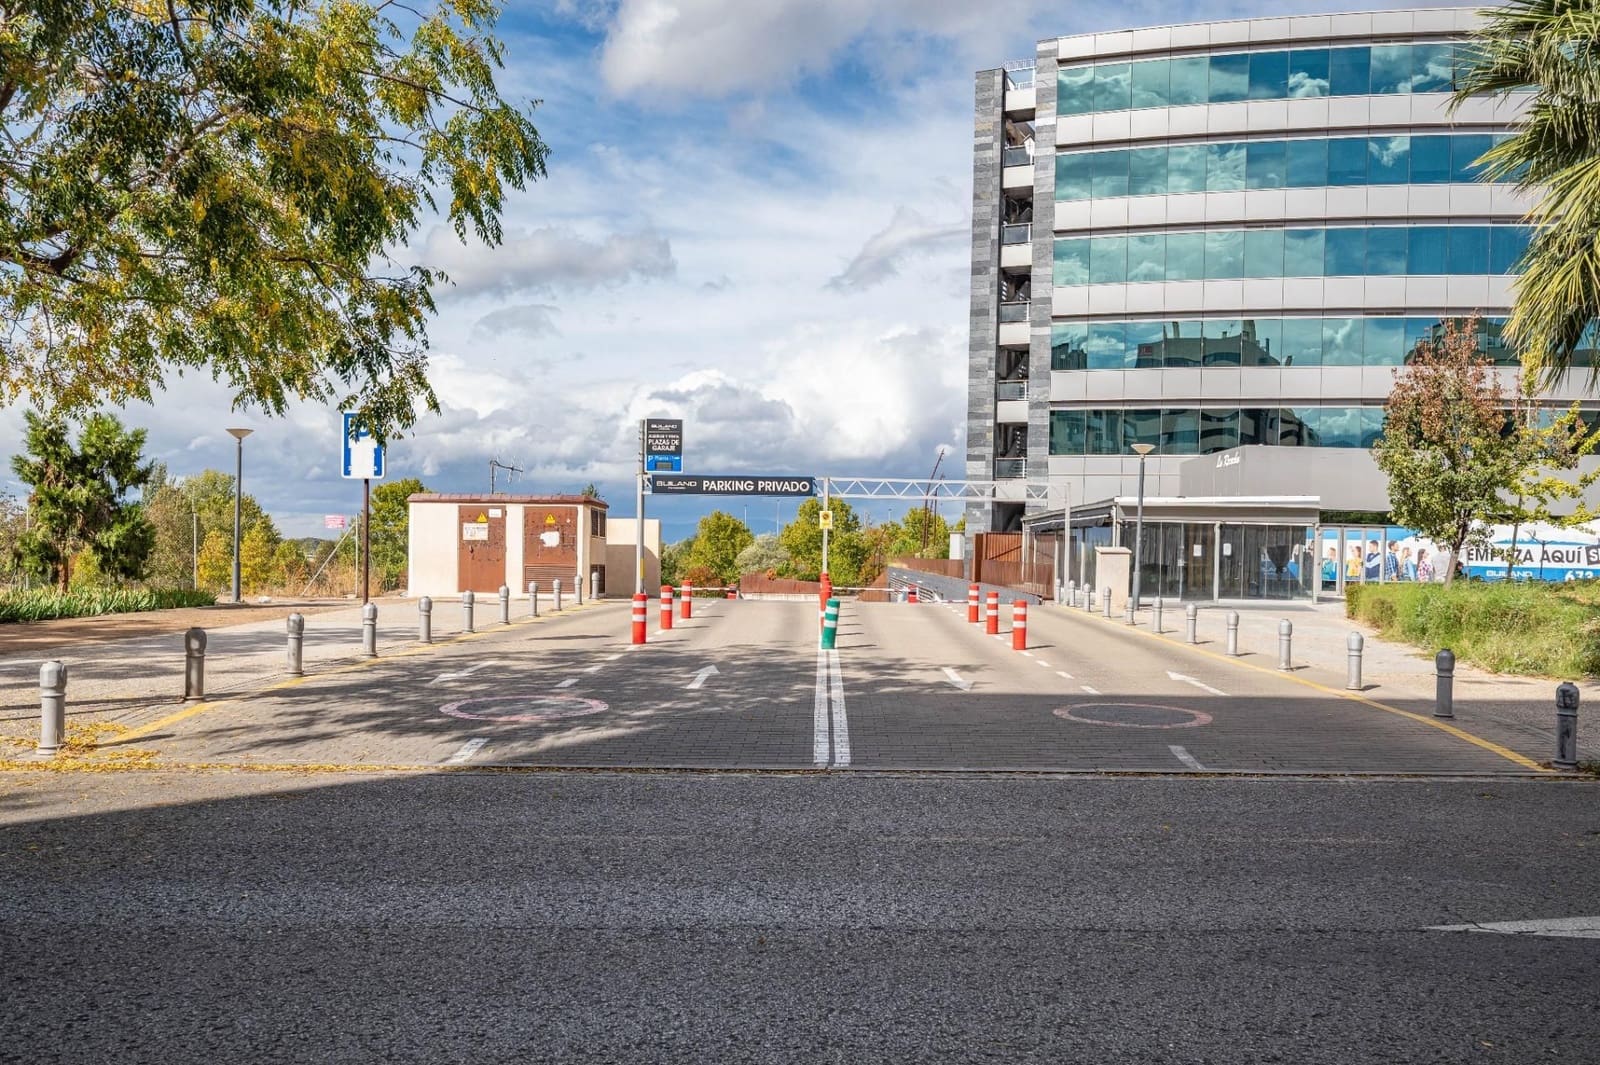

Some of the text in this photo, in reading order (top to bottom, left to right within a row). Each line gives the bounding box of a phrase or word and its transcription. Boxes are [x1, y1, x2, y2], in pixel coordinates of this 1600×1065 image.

[702, 480, 754, 492] PARKING
[758, 481, 810, 492] PRIVADO
[1467, 546, 1600, 563] EMPIZA AQUÍ S
